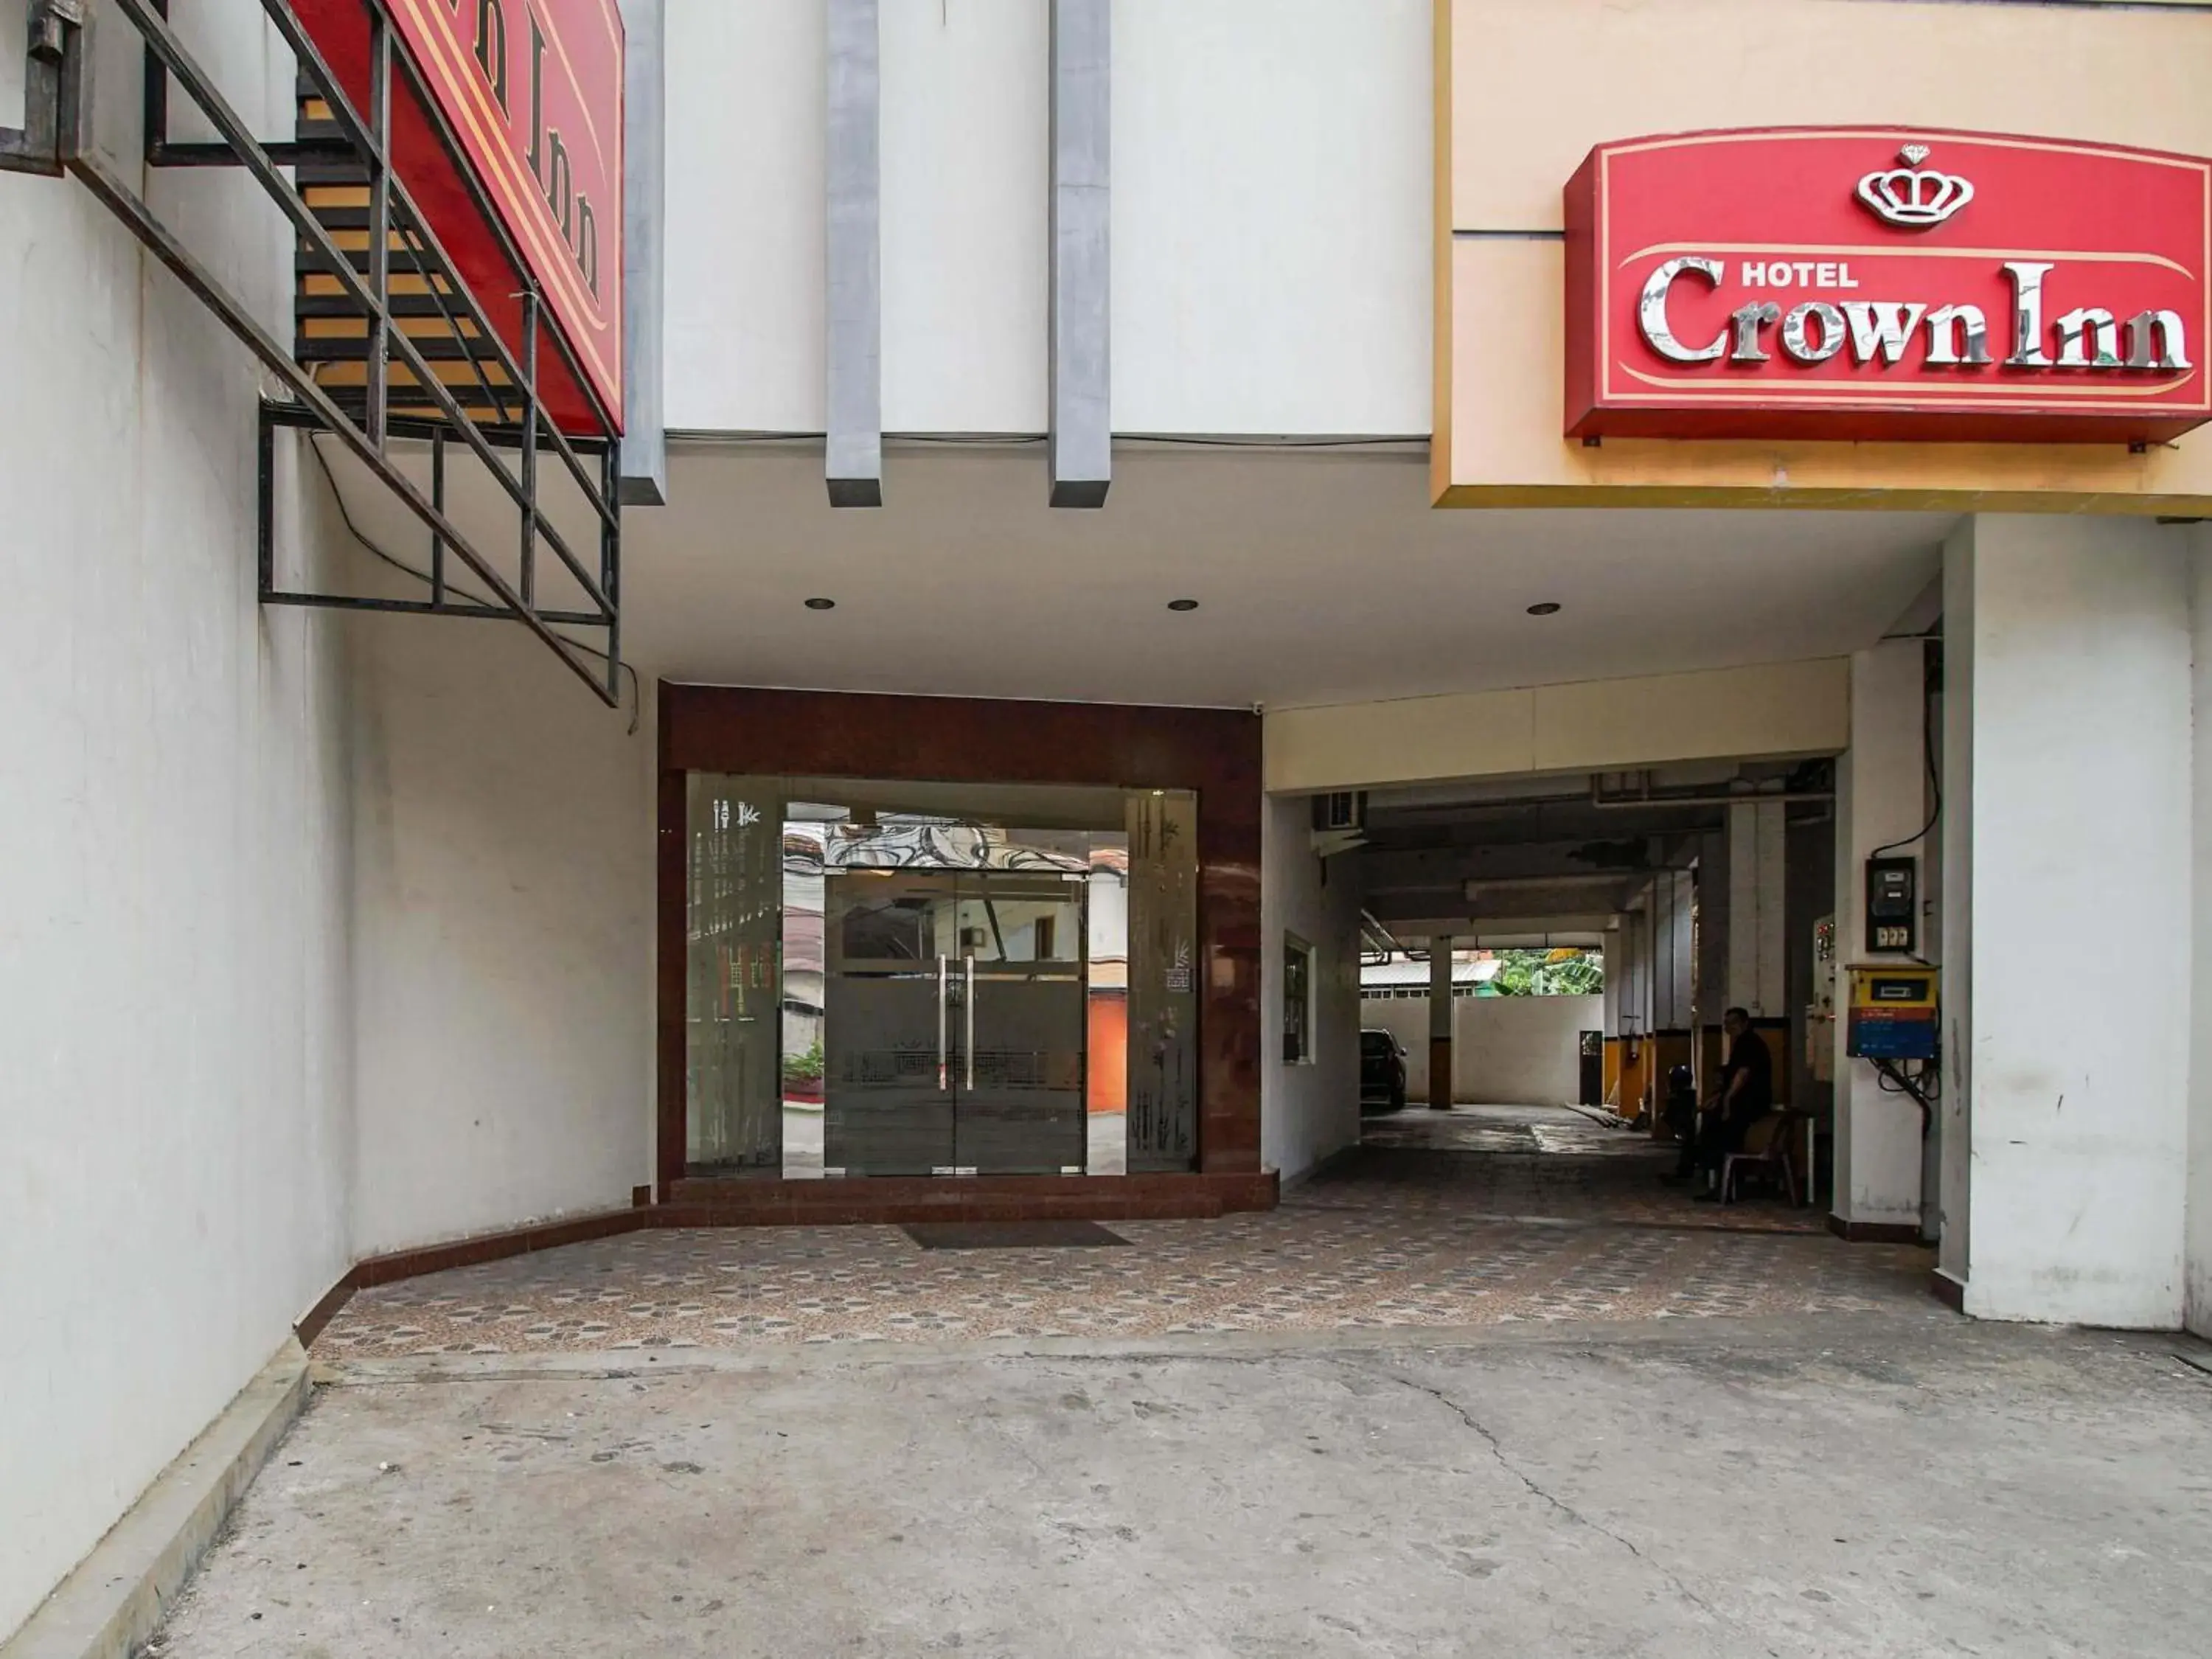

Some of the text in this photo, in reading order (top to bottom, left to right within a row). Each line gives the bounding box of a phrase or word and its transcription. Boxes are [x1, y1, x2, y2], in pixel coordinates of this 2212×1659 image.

[1742, 261, 1859, 288] HOTEL
[1637, 256, 2193, 369] Crown Inn
